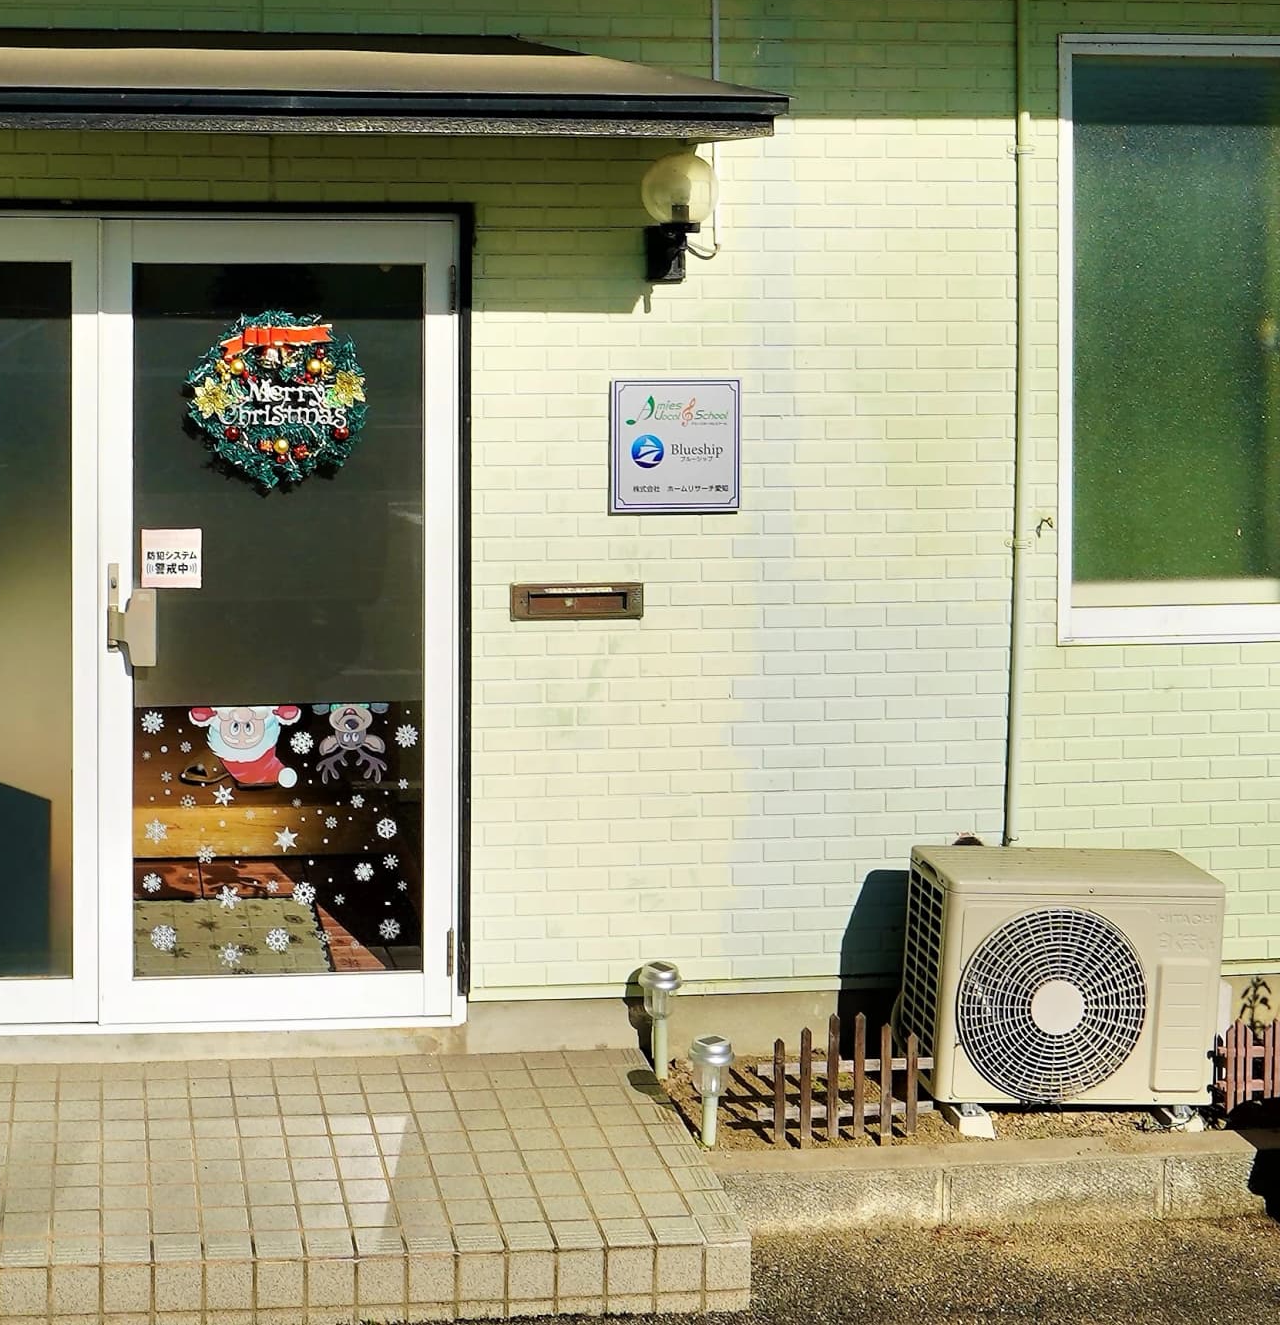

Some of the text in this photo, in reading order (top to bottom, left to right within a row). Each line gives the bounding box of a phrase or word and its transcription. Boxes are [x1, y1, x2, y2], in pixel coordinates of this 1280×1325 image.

[247, 378, 326, 407] Merry
[220, 403, 347, 427] Christmas
[694, 409, 729, 420] School
[671, 443, 724, 458] Blueship
[146, 551, 197, 561] 防犯システム
[154, 562, 189, 575] 警戒中
[1158, 913, 1217, 925] HITACHI
